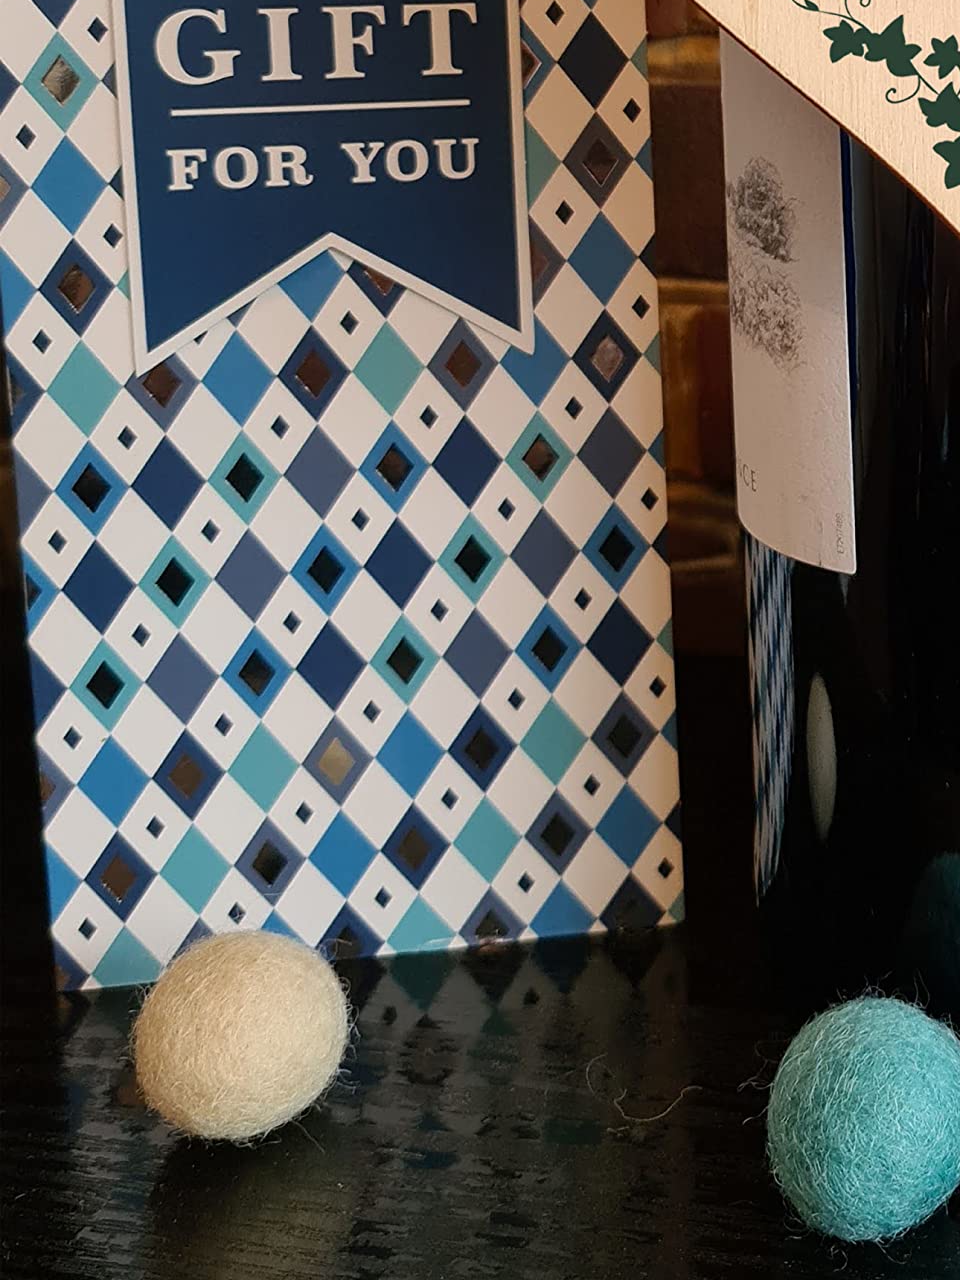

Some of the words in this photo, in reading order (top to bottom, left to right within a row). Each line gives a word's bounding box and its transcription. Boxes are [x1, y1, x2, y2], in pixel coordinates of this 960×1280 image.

[155, 2, 478, 87] GIFT
[166, 145, 315, 192] FOR
[341, 138, 481, 185] YOU
